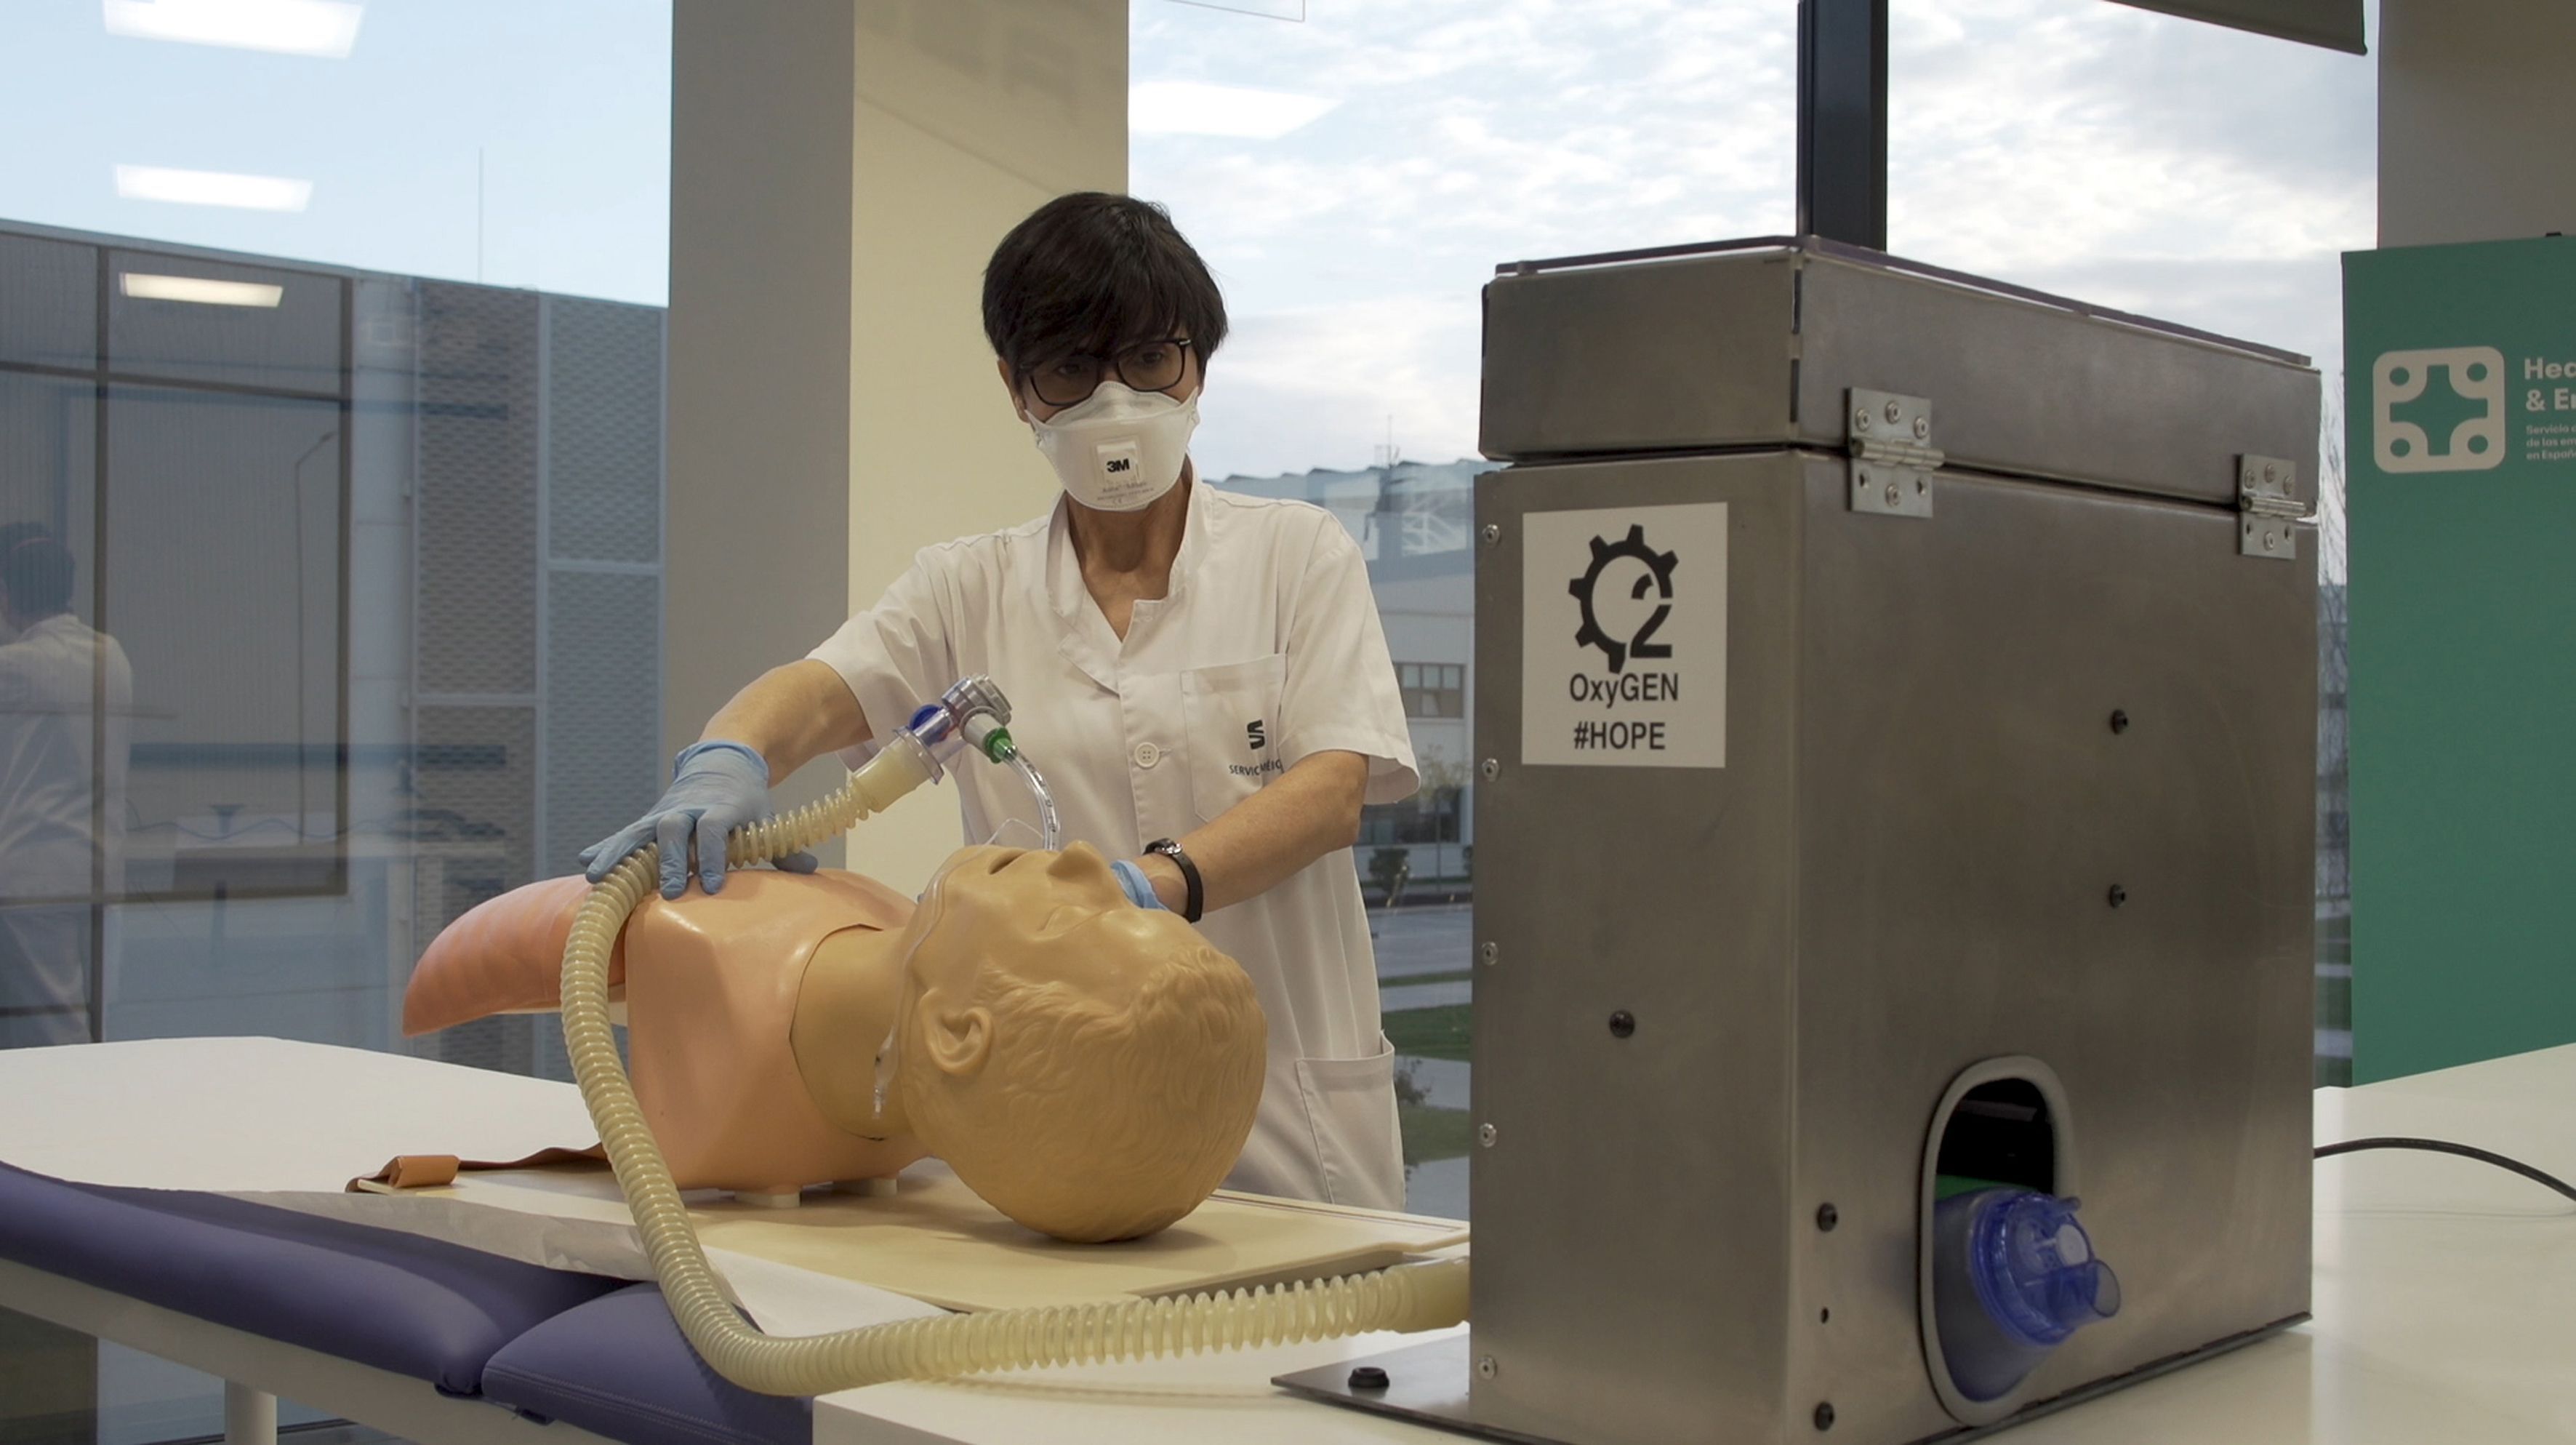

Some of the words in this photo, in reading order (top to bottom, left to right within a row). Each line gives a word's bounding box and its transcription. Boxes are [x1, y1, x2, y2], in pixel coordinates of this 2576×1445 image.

[2526, 389, 2545, 412] &
[2526, 424, 2569, 435] Servicio
[2526, 438, 2540, 447] de
[2542, 437, 2559, 447] los
[2526, 452, 2540, 460] en
[1106, 458, 1130, 473] 3M
[1570, 673, 1679, 709] OxyGEN
[1574, 721, 1666, 750] #HOPE
[1229, 764, 1260, 776] SERVIC
